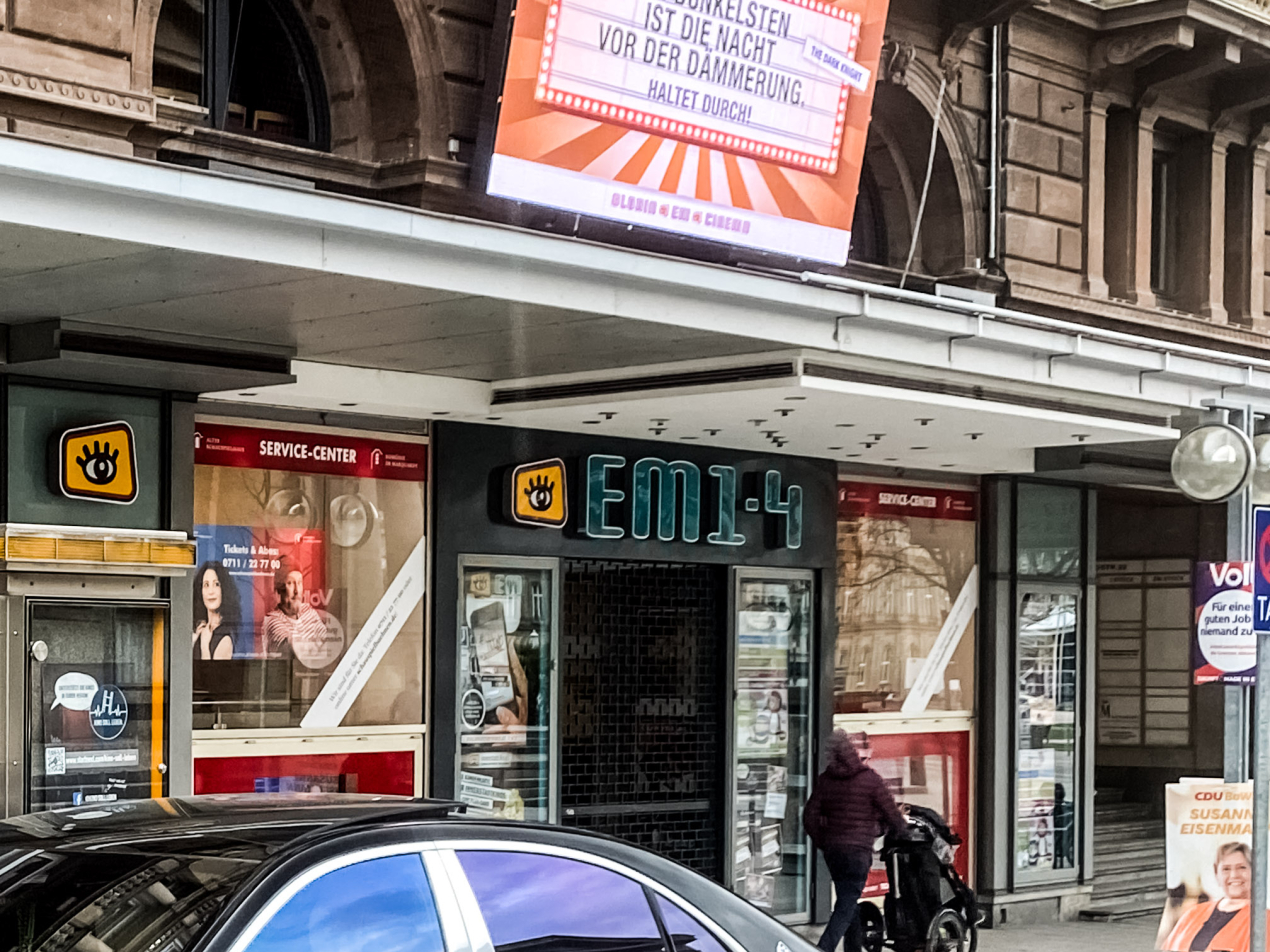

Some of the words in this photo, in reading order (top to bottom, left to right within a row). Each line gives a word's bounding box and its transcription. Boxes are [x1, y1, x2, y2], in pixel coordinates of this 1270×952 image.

[675, 0, 791, 38] NKELSTEN
[644, 2, 677, 35] IST
[681, 13, 712, 46] DIE
[716, 24, 777, 66] NACHT
[598, 22, 636, 60] VOR
[642, 38, 681, 73] DER
[687, 45, 805, 108] DÄMMERUNG.
[811, 45, 823, 60] THE
[823, 53, 840, 70] DARK
[840, 63, 863, 82] KNIGHT
[647, 79, 700, 110] HALTET
[702, 93, 753, 124] DURCH!
[259, 440, 357, 464] SERVICE-CENTER
[224, 544, 249, 554] Tickets
[251, 545, 256, 555] &
[222, 558, 241, 568] 0711
[248, 559, 258, 569] 22
[260, 559, 270, 569] 77
[271, 559, 281, 570] 00
[1212, 601, 1226, 612] Für
[1228, 602, 1253, 612] eine
[1204, 615, 1229, 625] guten
[1231, 614, 1251, 623] Job
[1200, 626, 1238, 636] niemand
[1194, 791, 1223, 801] CDU
[1189, 808, 1253, 820] SUSANN
[1180, 823, 1253, 835] EISENMA
